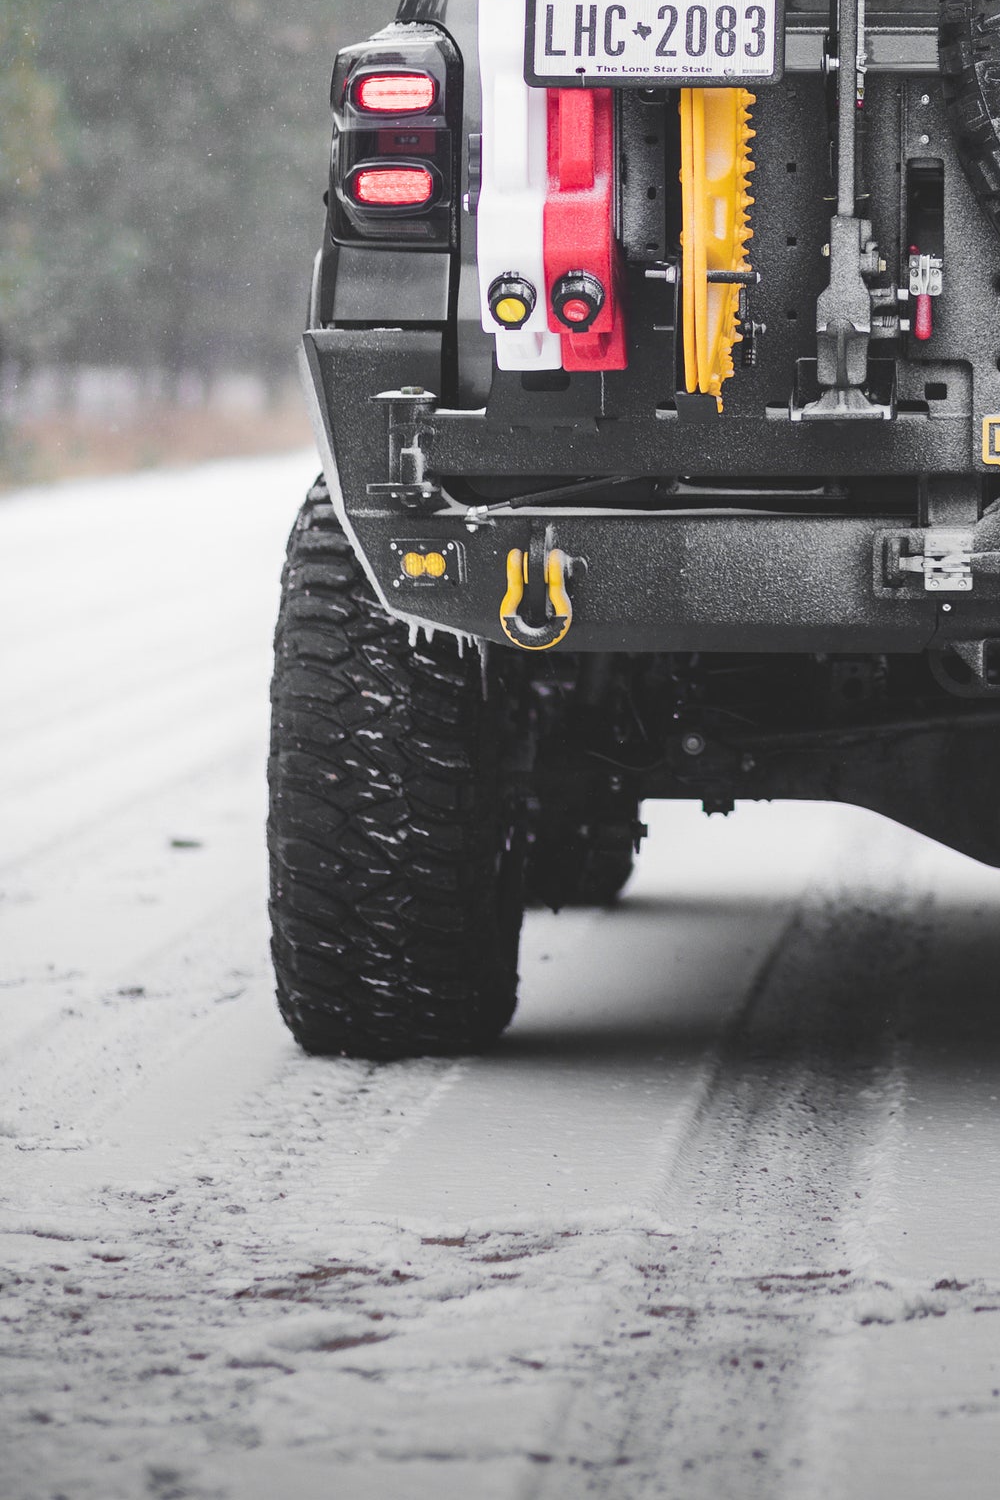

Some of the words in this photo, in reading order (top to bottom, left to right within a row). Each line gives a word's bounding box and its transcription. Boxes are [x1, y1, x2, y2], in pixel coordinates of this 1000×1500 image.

[544, 4, 627, 57] LHC
[655, 4, 767, 58] 2083
[596, 65, 619, 74] The
[622, 65, 650, 74] Lone
[653, 65, 679, 74] Star
[682, 65, 713, 74] State
